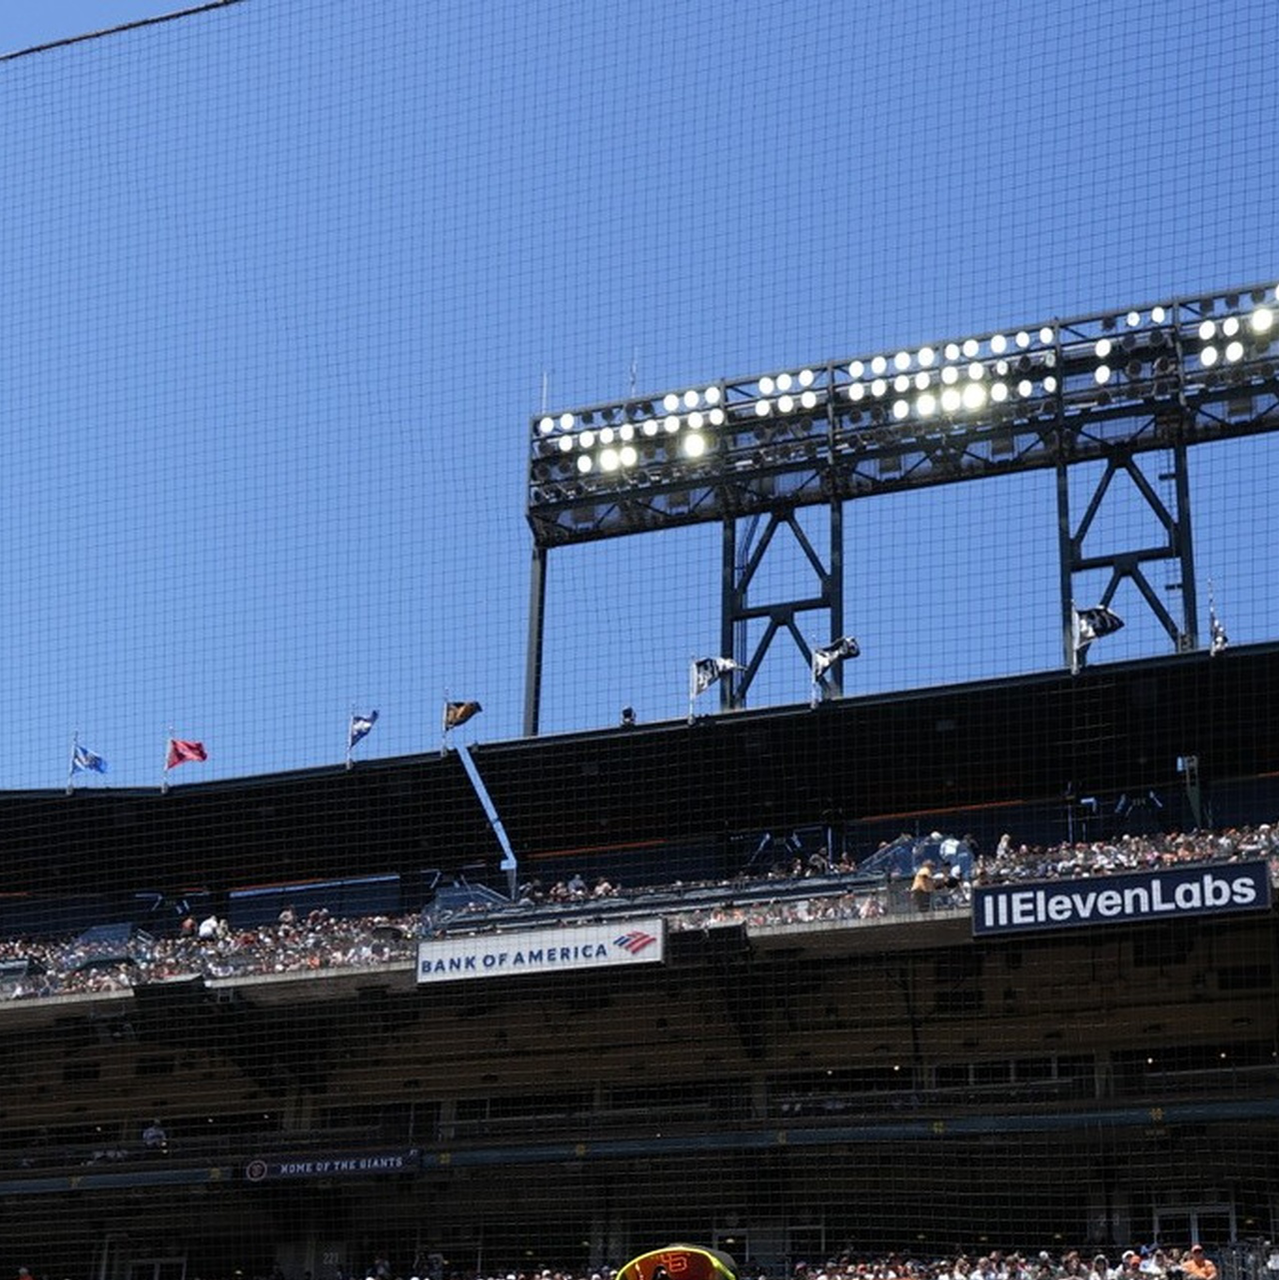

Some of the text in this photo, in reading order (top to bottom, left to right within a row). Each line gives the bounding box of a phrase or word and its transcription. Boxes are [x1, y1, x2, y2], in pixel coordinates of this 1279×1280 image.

[421, 943, 608, 974] BANK OF AMERICA
[280, 1156, 403, 1174] HOME OF THE GIANTS
